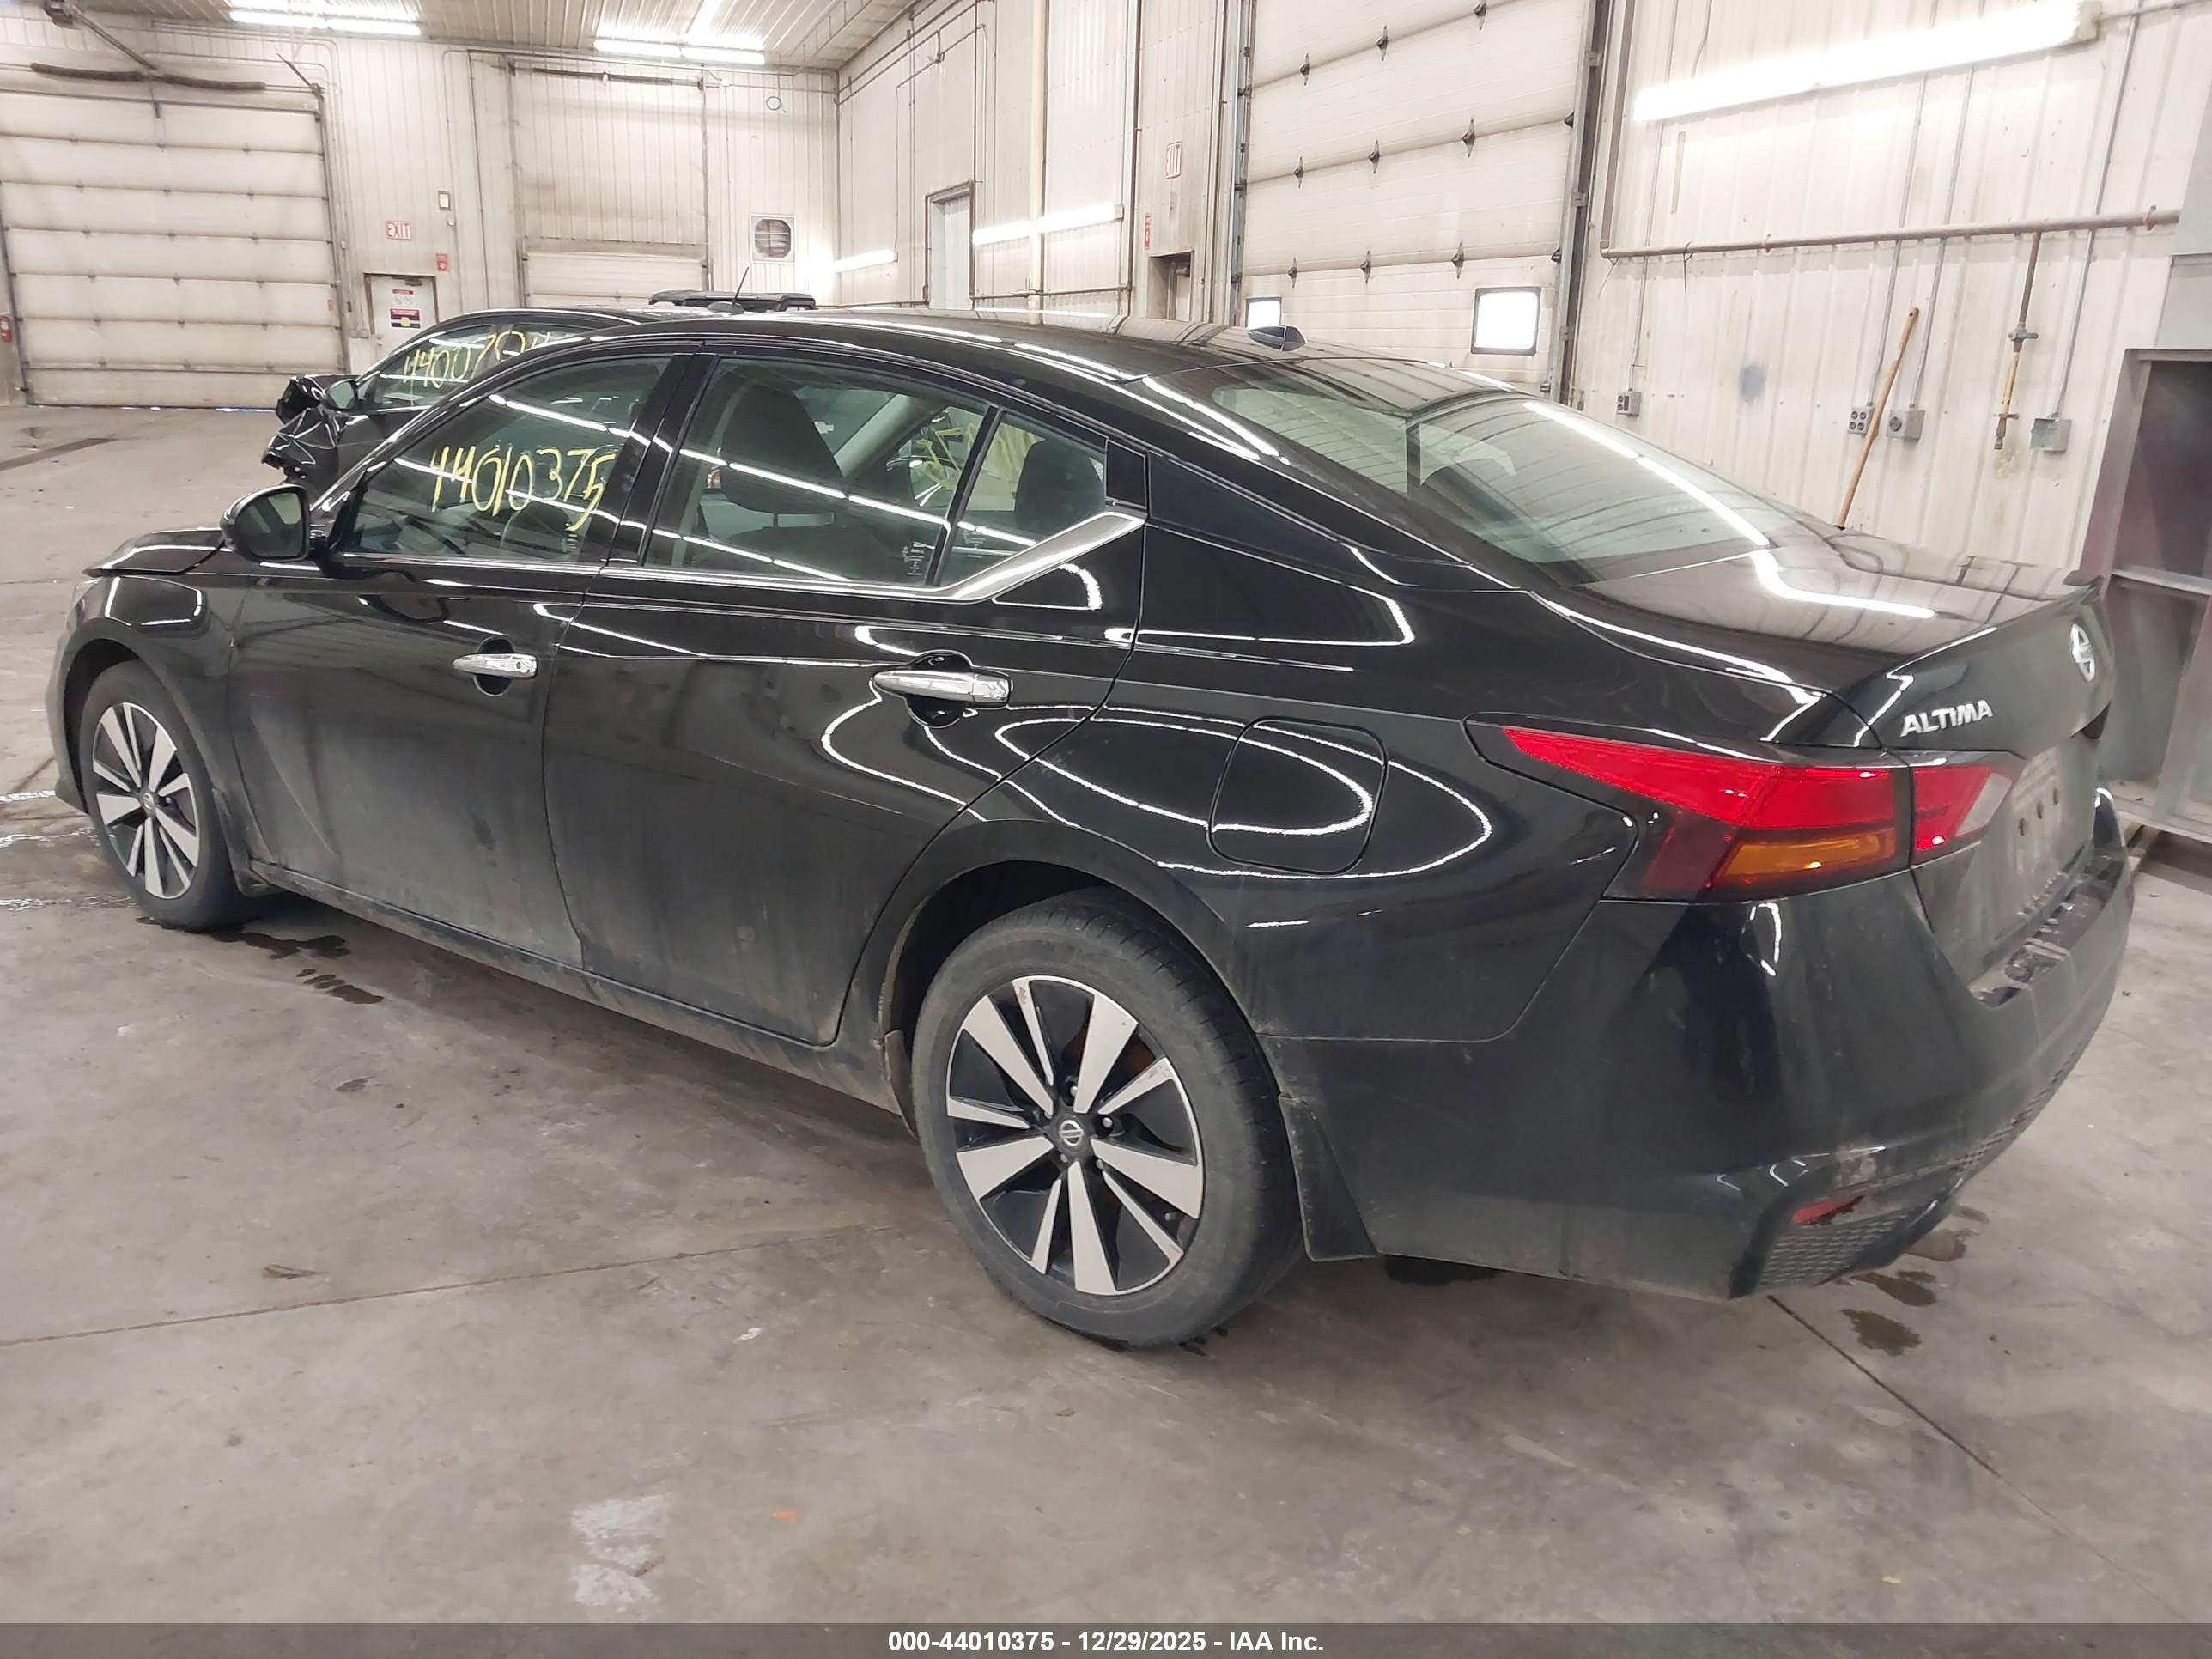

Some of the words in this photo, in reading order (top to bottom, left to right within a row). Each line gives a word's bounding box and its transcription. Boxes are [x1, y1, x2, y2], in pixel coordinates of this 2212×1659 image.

[1166, 144, 1181, 177] EXIT
[386, 221, 410, 239] EXIT
[430, 444, 617, 532] 44010375
[1900, 700, 1993, 737] ALTIMA
